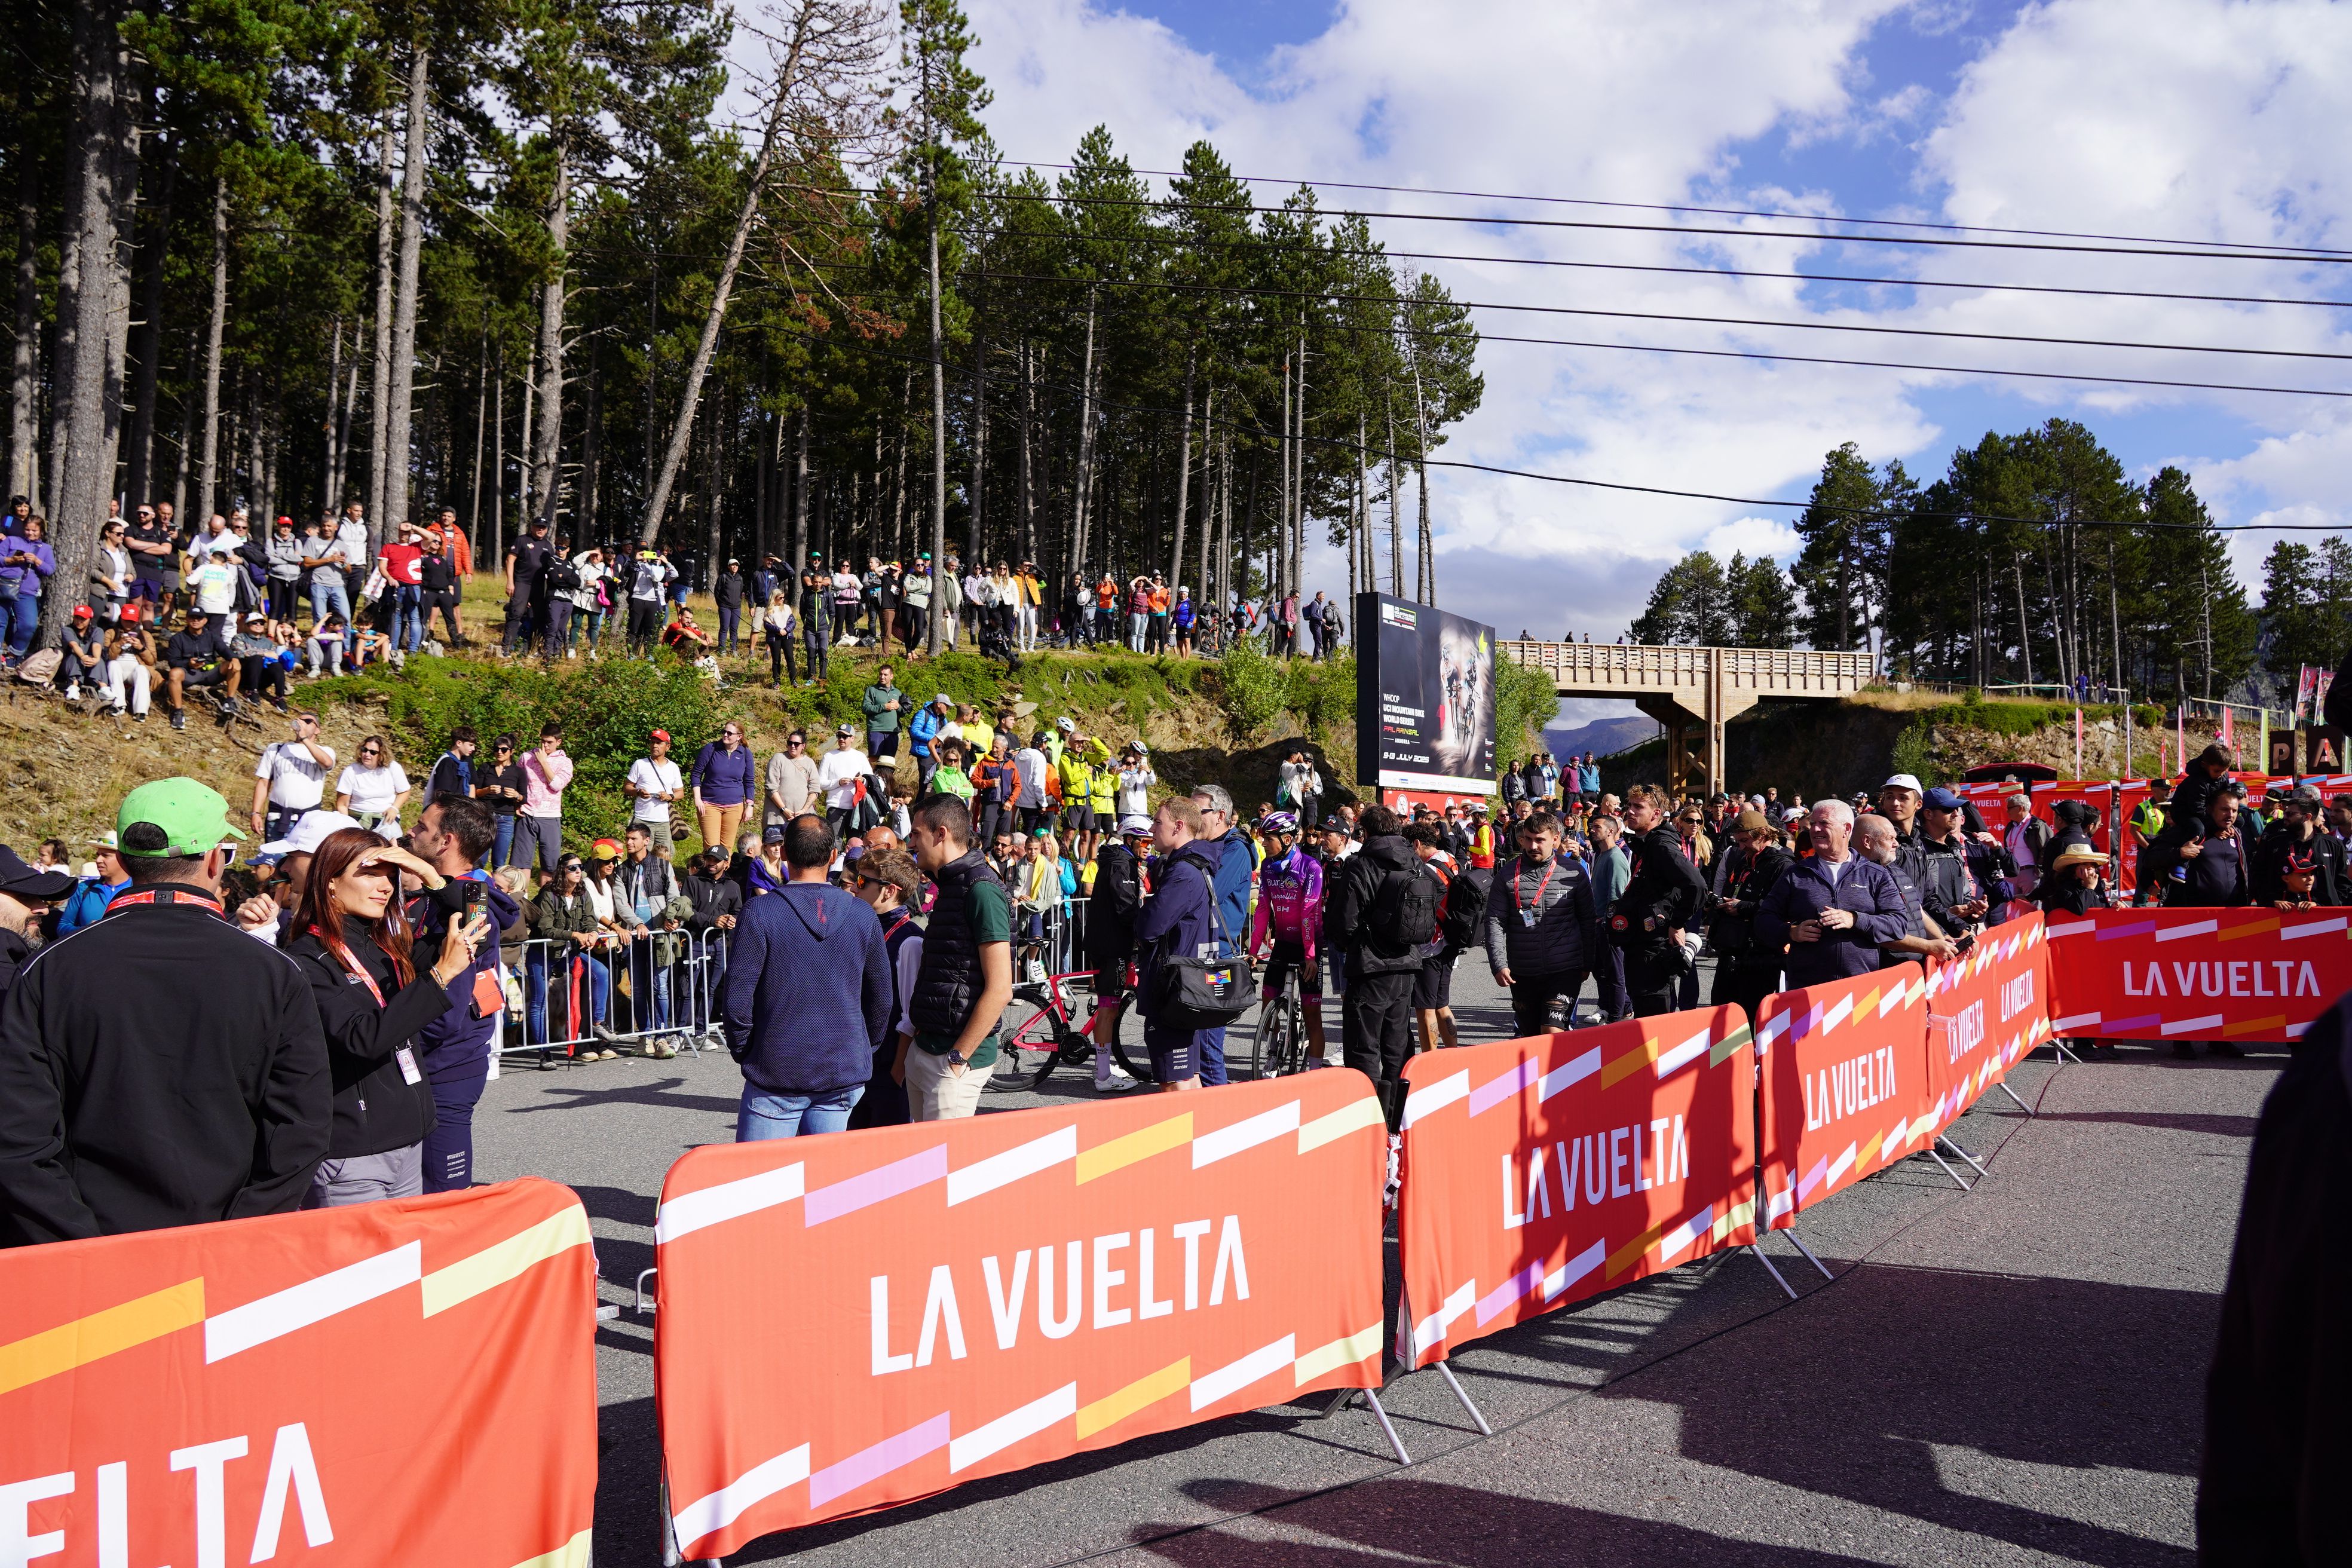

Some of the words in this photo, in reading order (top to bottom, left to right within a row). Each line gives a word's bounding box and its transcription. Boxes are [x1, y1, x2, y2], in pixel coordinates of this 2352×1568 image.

[1383, 693, 1399, 703] WHOOP
[1383, 704, 1392, 712] UCI
[1392, 705, 1415, 716] MOUNTAIN
[1414, 709, 1425, 718] BIKE
[1383, 714, 1399, 724] WORLD
[1399, 716, 1414, 726] SERIES
[1395, 727, 1420, 736] ARINSAL
[2001, 982, 2011, 1023] LA
[2011, 968, 2034, 1016] VUELTA
[2123, 961, 2168, 996] LA
[2173, 960, 2321, 997] VUELTA
[1948, 1015, 1958, 1065] LA
[1958, 998, 1984, 1057] VUELTA
[1806, 1069, 1830, 1132] LA
[1832, 1045, 1896, 1120] VUELTA
[1502, 1147, 1551, 1230] LA
[1556, 1114, 1689, 1212] VUELTA
[871, 1264, 967, 1376] LA
[981, 1214, 1250, 1350] VUELTA
[0, 1421, 335, 1568] ELTA
